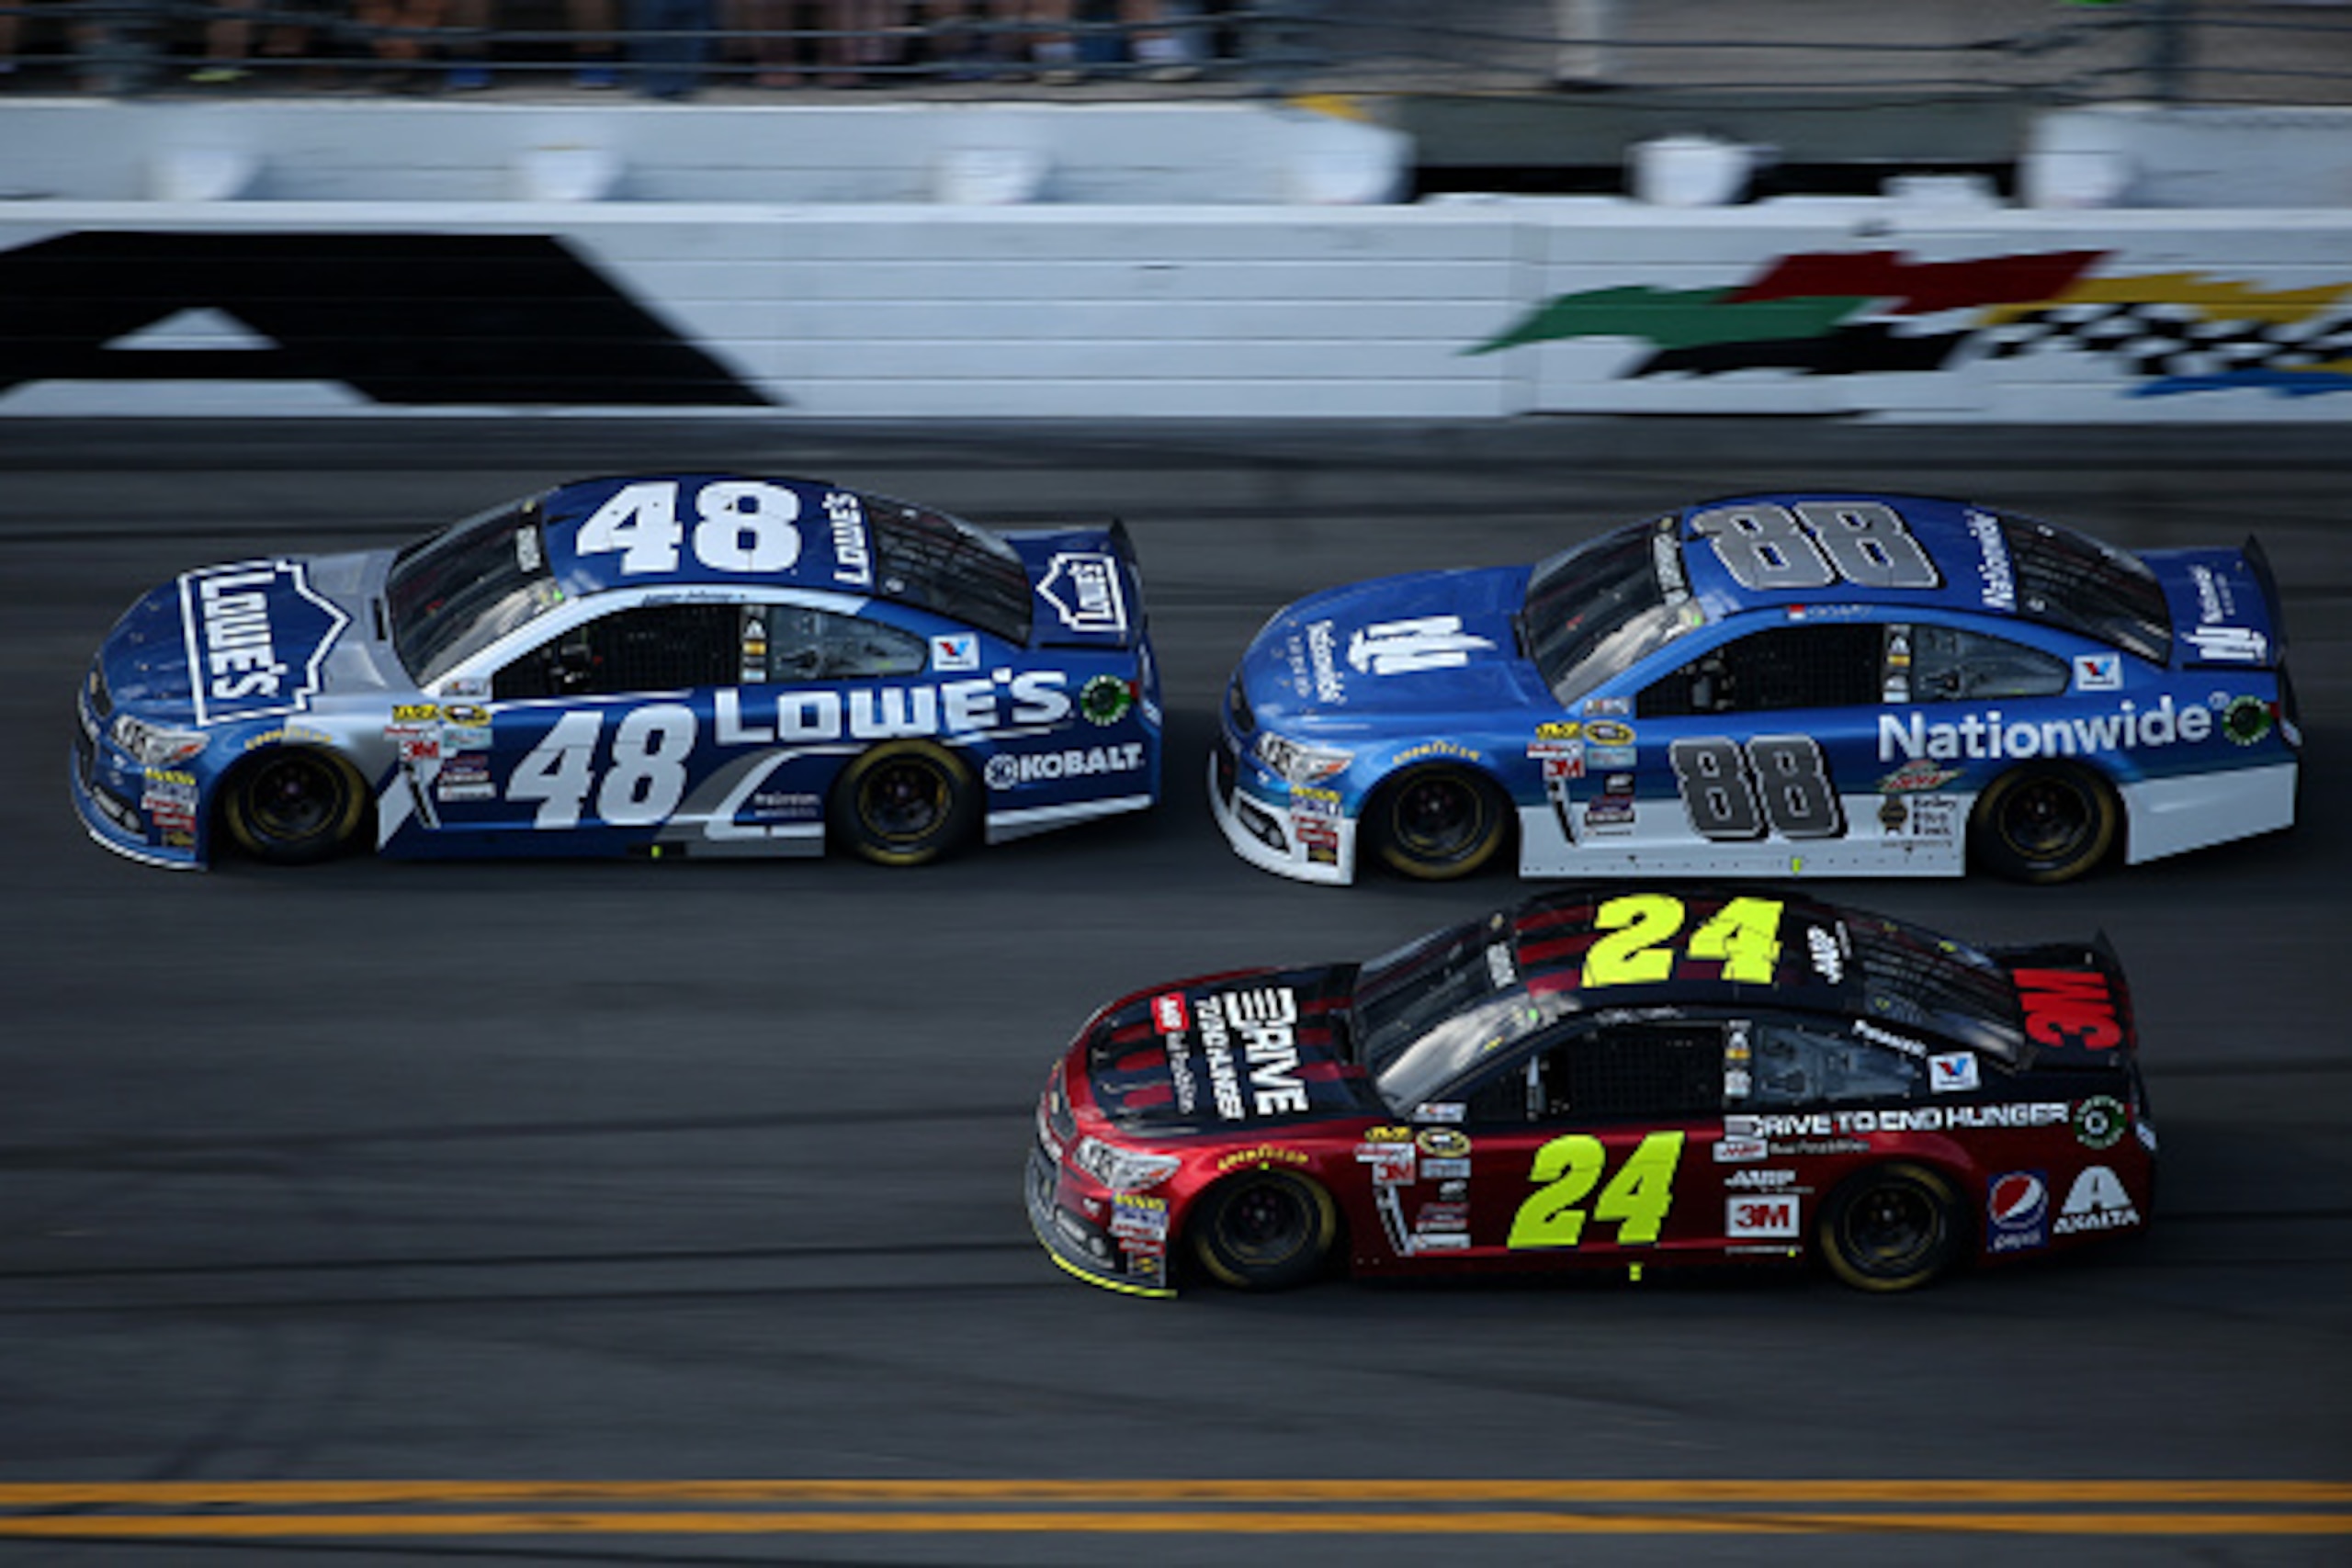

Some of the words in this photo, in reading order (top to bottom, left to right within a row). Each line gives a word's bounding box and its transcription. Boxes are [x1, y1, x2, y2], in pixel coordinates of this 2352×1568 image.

[575, 479, 801, 575] 48
[823, 492, 871, 586] LOWE'S
[1690, 501, 1940, 591] 88
[199, 570, 289, 700] LOWE'S
[402, 739, 439, 762] 3M
[714, 667, 1072, 745] LOWE'S
[1879, 694, 2212, 761] Nationwide
[504, 704, 698, 829] 48
[1020, 742, 1143, 782] KOBALT
[1669, 734, 1843, 839] 88
[1581, 893, 1784, 987] 24
[1223, 987, 1309, 1116] DRIVE
[2013, 968, 2122, 1050] 3M
[1724, 1114, 1832, 1141] DRIVE
[1836, 1111, 1877, 1134] TO
[1880, 1105, 1944, 1132] END
[1946, 1101, 2069, 1128] HUNGER
[1507, 1131, 1685, 1248] 24
[1735, 1204, 1790, 1228] 3M
